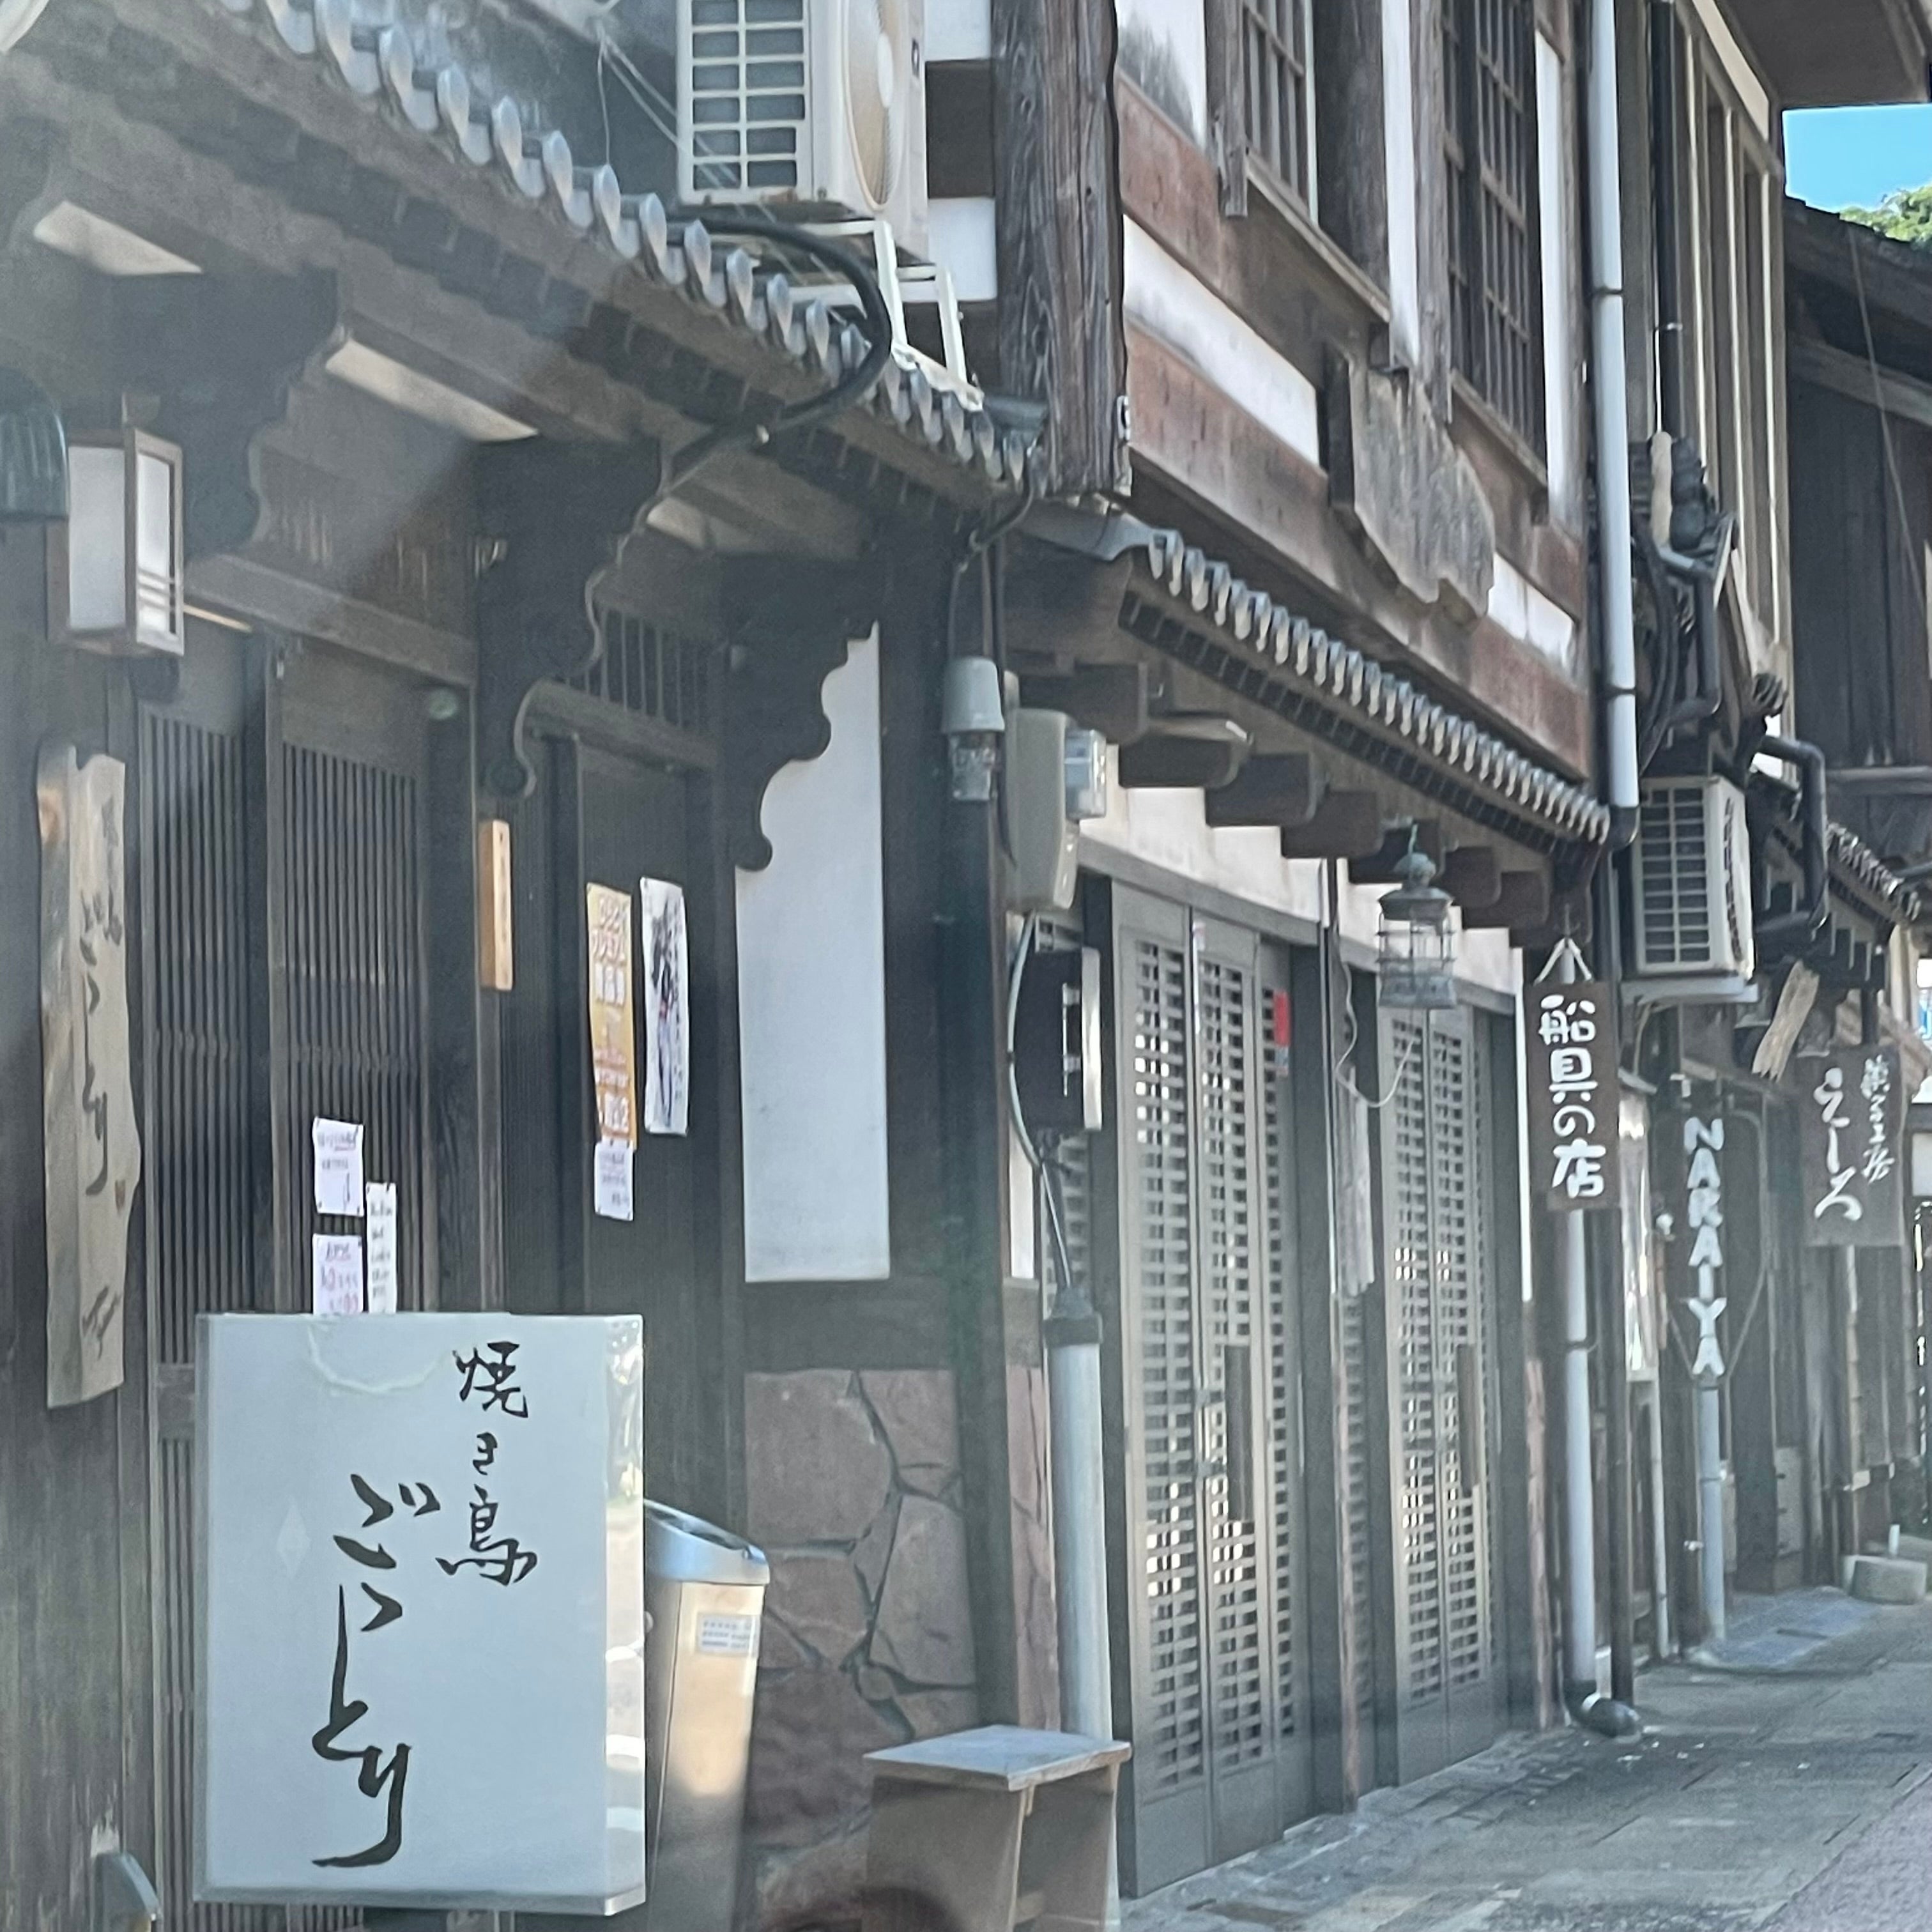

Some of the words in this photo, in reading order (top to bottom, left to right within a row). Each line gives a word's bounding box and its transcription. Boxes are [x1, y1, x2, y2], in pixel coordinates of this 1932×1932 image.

[1538, 994, 1606, 1198] 船具の店
[1683, 1116, 1727, 1376] NARAIYA
[436, 1340, 537, 1586] 焼き鳥
